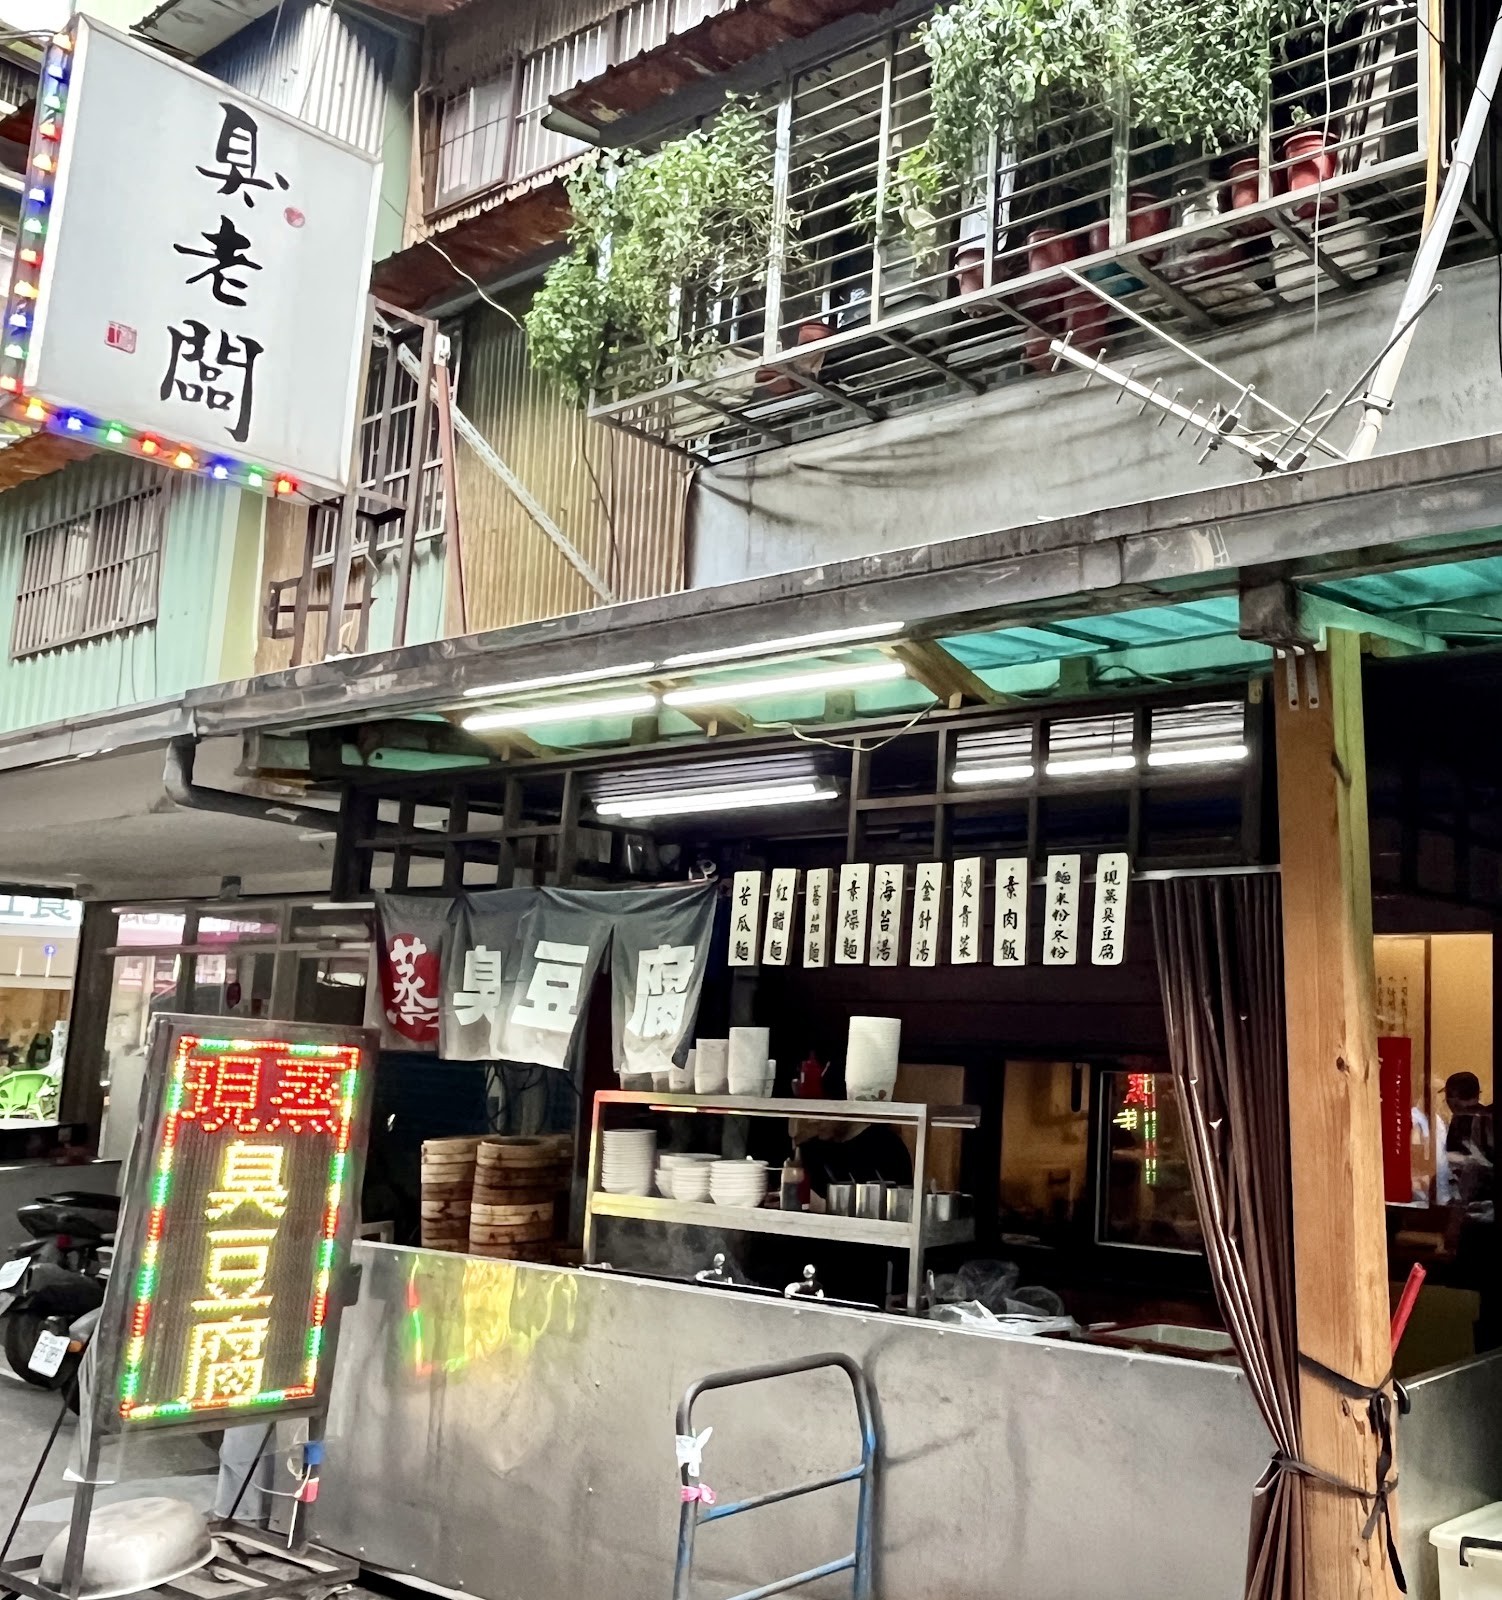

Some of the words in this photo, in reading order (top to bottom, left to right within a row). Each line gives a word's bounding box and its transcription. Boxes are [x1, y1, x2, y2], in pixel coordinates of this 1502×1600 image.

[160, 102, 289, 442] 臭老闆
[734, 886, 752, 962] 苦瓜麵
[876, 879, 896, 961] 海苔湯
[916, 879, 935, 962] 金針湯
[1001, 875, 1019, 961] 素肉飯
[1098, 869, 1120, 960] 現蒸臭豆腐
[181, 1056, 346, 1133] 現蒸
[187, 1140, 289, 1403] 臭豆腐
